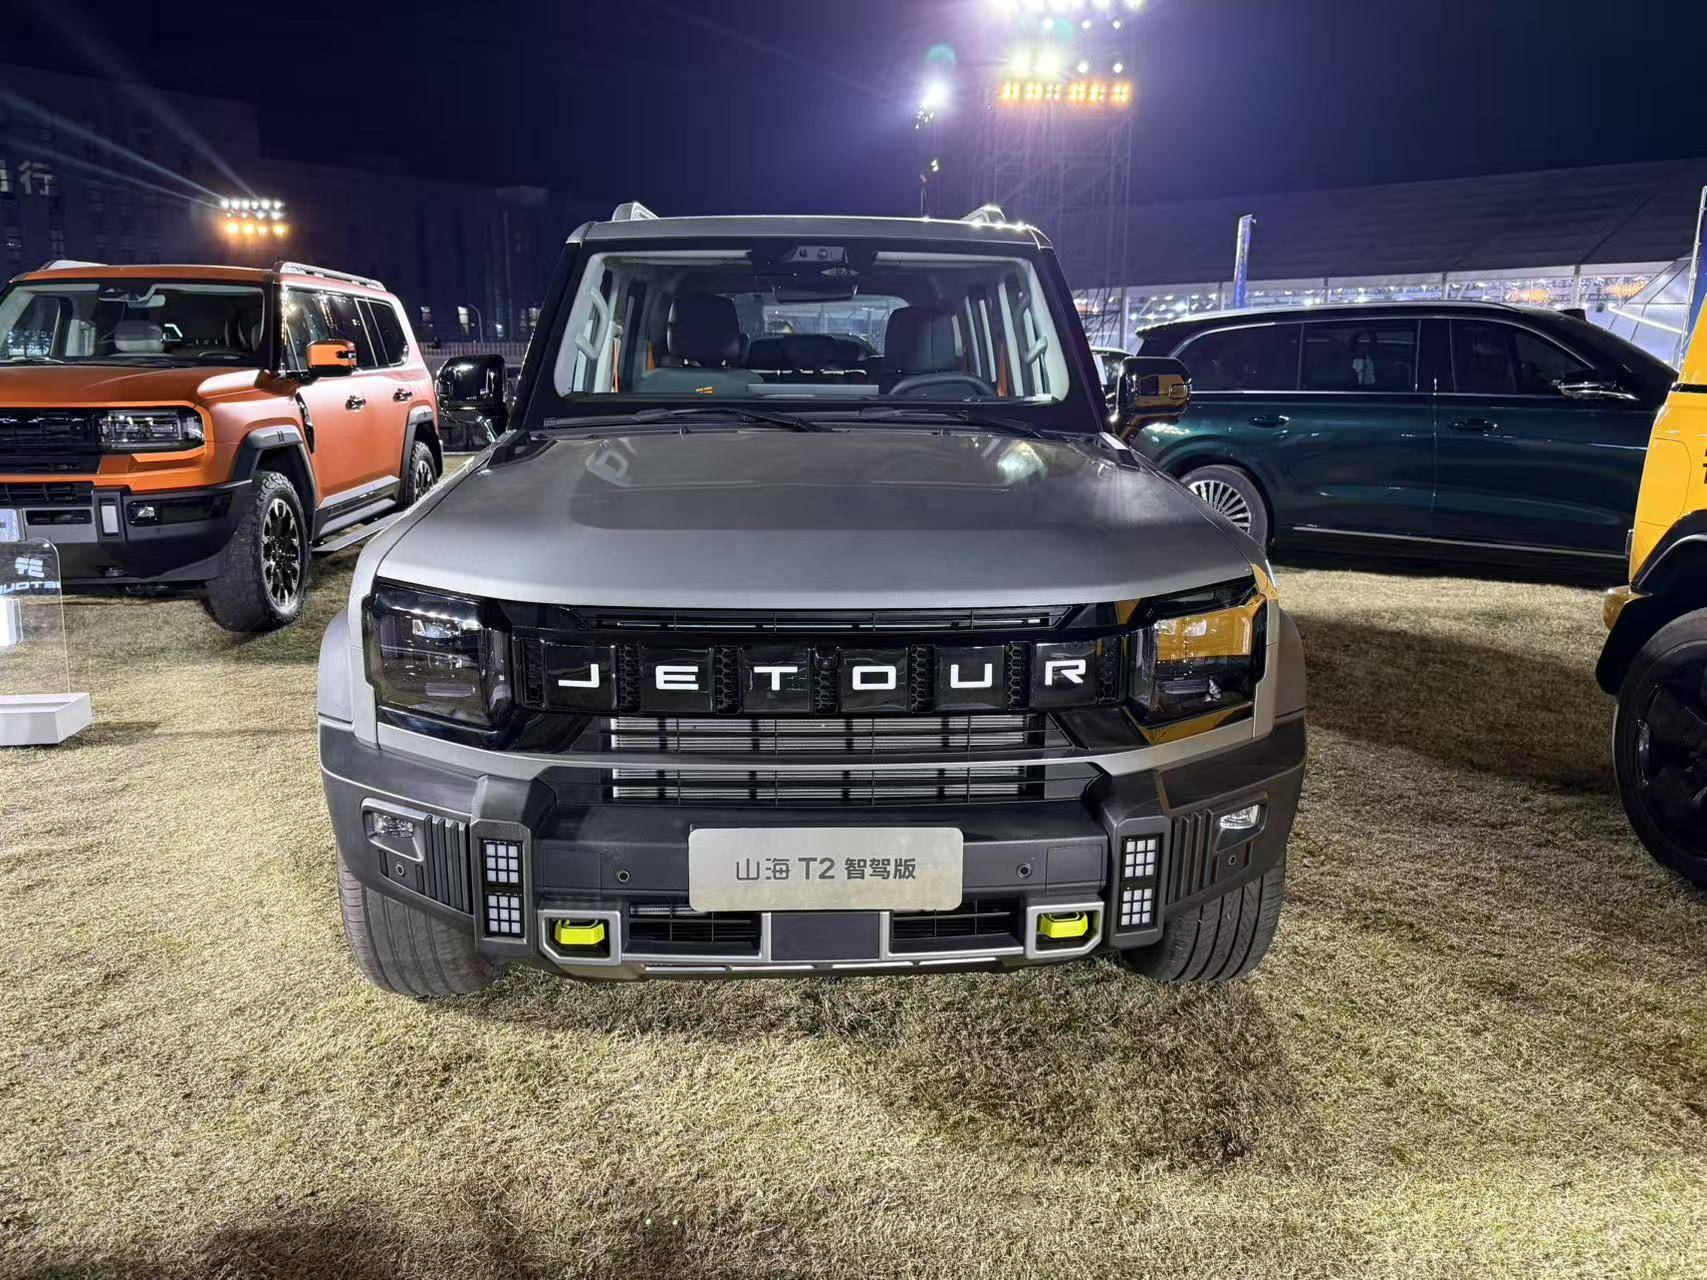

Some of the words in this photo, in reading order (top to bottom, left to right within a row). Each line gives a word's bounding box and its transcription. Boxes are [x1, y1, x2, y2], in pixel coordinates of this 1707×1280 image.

[558, 659, 1087, 690] JETOUR
[736, 857, 791, 881] 山海
[798, 857, 835, 880] T2
[845, 857, 917, 881] 智驾版
